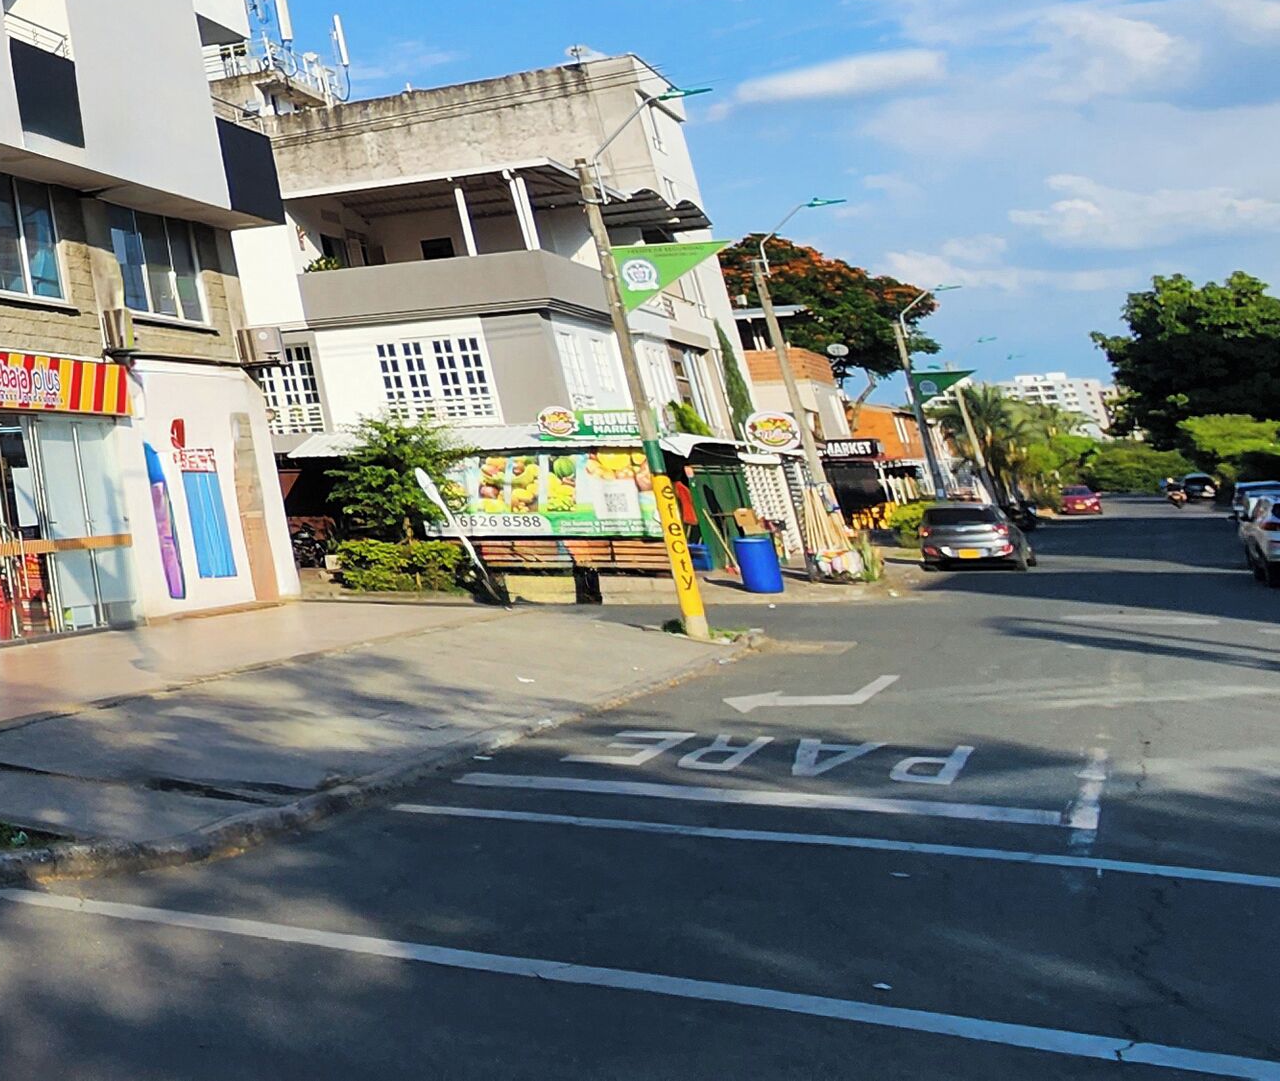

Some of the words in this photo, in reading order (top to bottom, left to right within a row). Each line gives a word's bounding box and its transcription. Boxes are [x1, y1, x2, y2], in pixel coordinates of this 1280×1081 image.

[32, 364, 60, 398] plus
[583, 413, 638, 426] FRUVE
[502, 515, 542, 528] 8588
[661, 485, 693, 591] efecty
[561, 729, 976, 786] PARE
